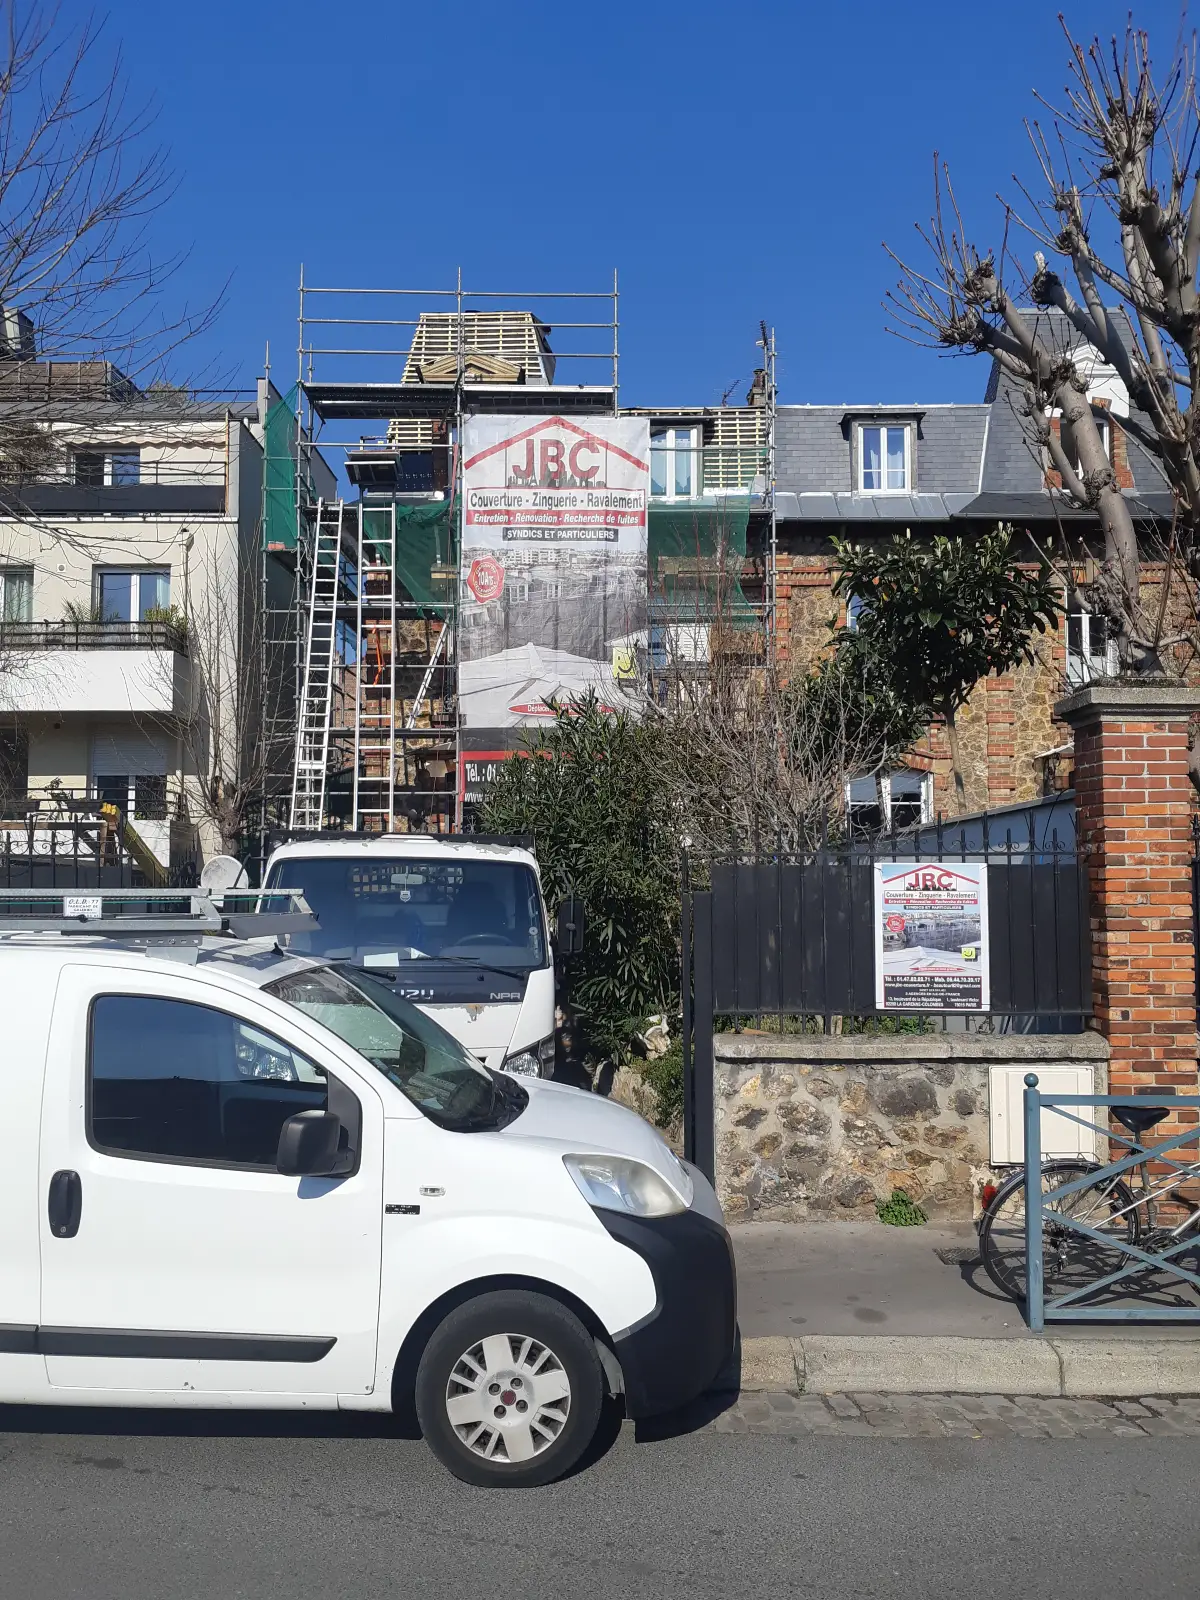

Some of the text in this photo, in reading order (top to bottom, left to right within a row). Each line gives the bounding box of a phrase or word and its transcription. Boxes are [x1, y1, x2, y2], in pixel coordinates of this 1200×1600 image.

[512, 438, 600, 480] JBC
[470, 492, 522, 507] Couverture
[532, 492, 577, 510] Zinguerie
[587, 492, 642, 508] Ravalement
[474, 513, 508, 522] Entretien
[516, 512, 557, 523] Rénovation
[564, 513, 604, 522] Recherche
[606, 514, 615, 523] de
[618, 515, 638, 524] fuites
[507, 530, 614, 539] SYNDICS ET PARTICULIERS
[466, 764, 480, 782] Tél.
[908, 872, 953, 888] JBC
[490, 992, 521, 1000] NPR
